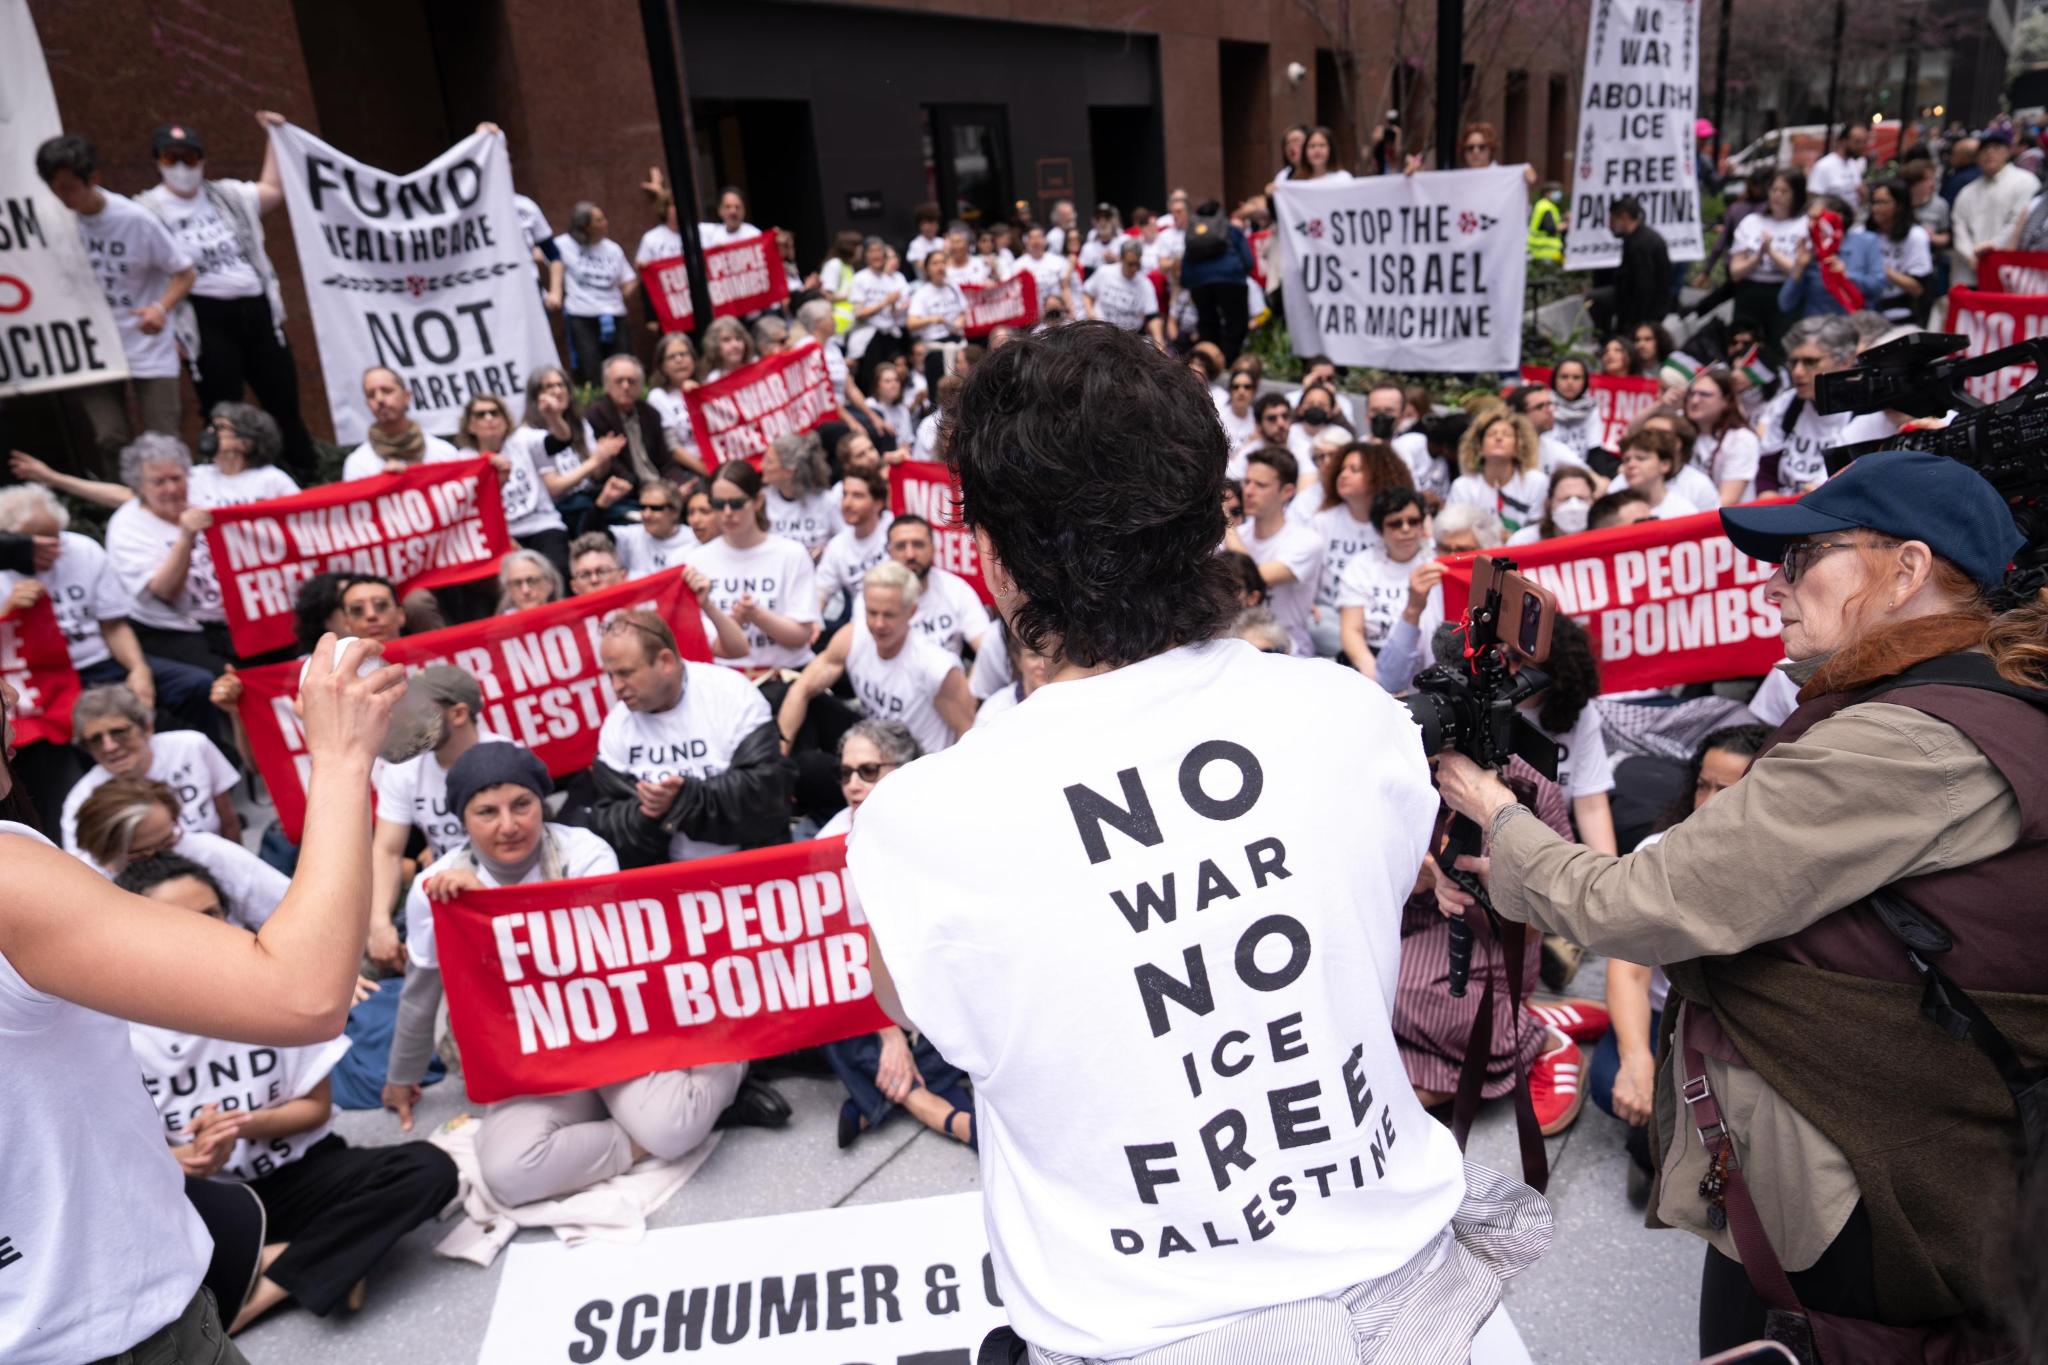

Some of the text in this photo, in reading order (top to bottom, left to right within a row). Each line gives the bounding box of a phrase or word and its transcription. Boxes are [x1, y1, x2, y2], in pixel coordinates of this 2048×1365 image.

[1620, 113, 1665, 141] ICE
[306, 155, 483, 220] FUND
[1604, 156, 1677, 187] FREE
[1330, 204, 1450, 246] STOP THE
[1576, 188, 1696, 231] PASTINE
[657, 263, 689, 293] FU
[365, 299, 496, 368] NOT
[1364, 304, 1491, 338] MACHINE
[408, 361, 524, 412] ARFARE
[733, 372, 788, 421] WAR
[220, 475, 480, 572] NO WAR NO ICE
[775, 519, 816, 533] UND
[931, 530, 979, 577] REE
[1523, 535, 1780, 615] ND PEOPL
[1601, 583, 1783, 662] BOMBS
[501, 623, 583, 694] NO
[629, 739, 708, 765] FUND
[415, 797, 448, 817] FU
[1062, 739, 1264, 865] NO
[1108, 836, 1293, 934] WAR
[492, 898, 673, 984] FUND
[508, 930, 875, 1056] NOT BOMB
[1133, 913, 1312, 1039] NO
[1182, 1010, 1310, 1099] ICE
[1124, 1042, 1374, 1206] FREE
[1110, 1105, 1398, 1259] PALESTINE
[568, 1264, 903, 1365] SCHUMER
[924, 1263, 961, 1317] &
